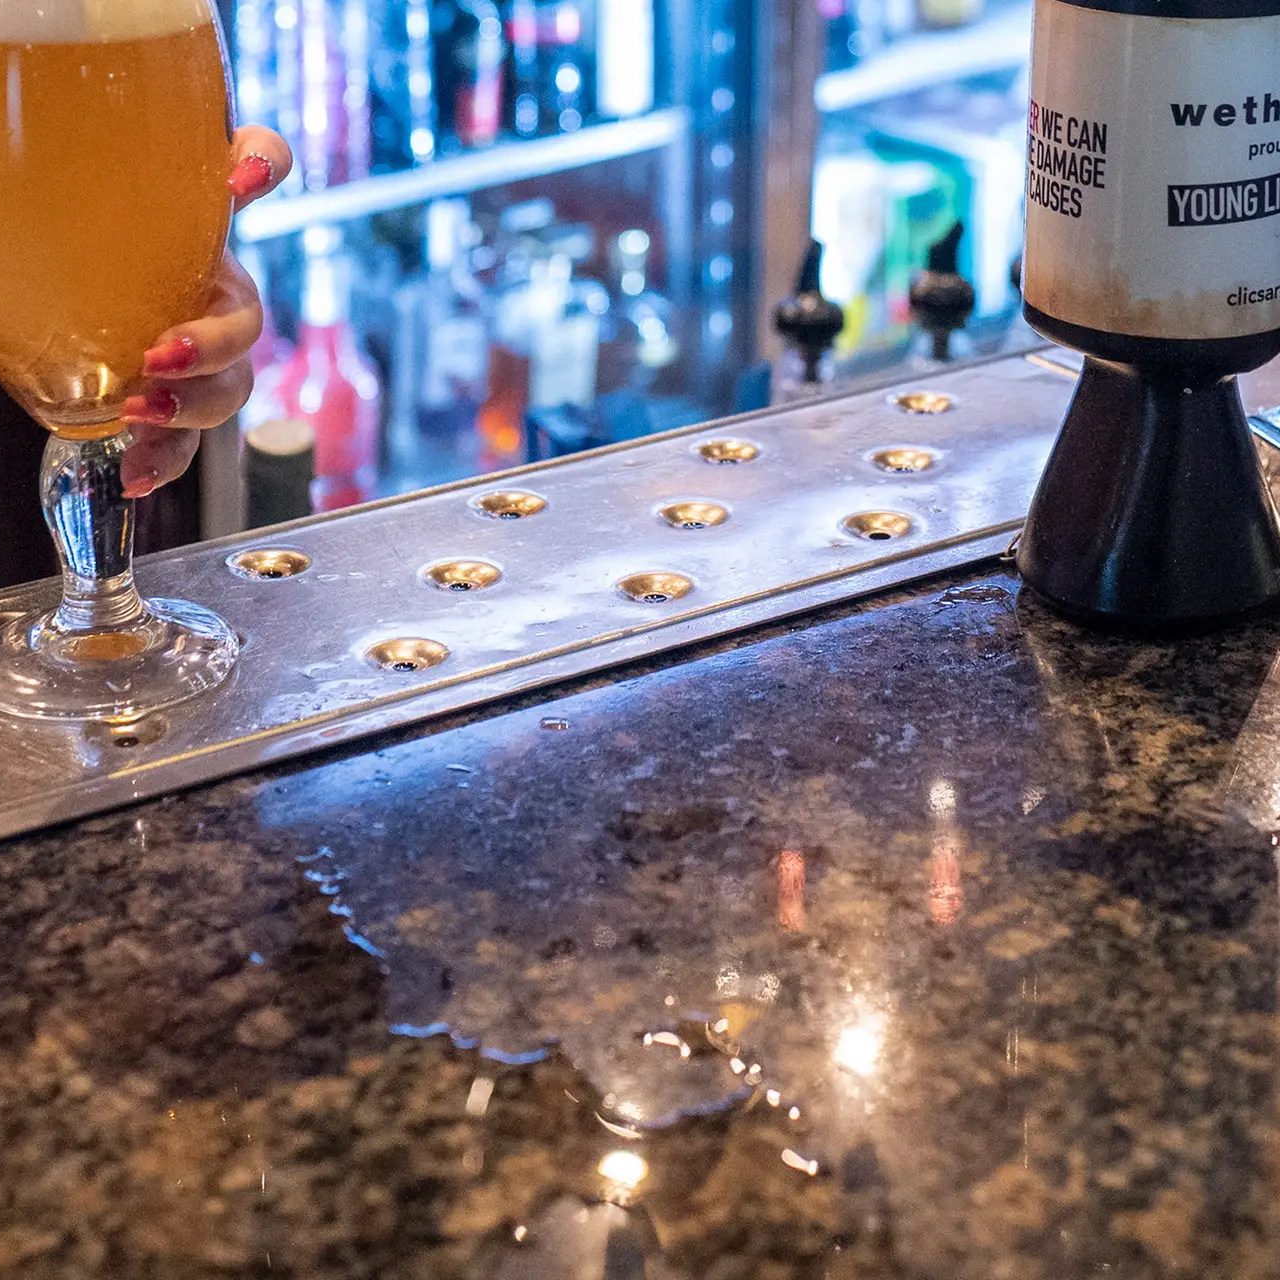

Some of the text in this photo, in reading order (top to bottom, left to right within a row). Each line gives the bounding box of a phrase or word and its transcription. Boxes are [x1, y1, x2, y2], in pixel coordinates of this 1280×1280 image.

[1042, 107, 1064, 144] WE
[1067, 117, 1107, 154] CAN
[1037, 140, 1106, 188] DAMAGE
[1028, 170, 1083, 218] CAUSES
[1172, 183, 1259, 223] YOUNG
